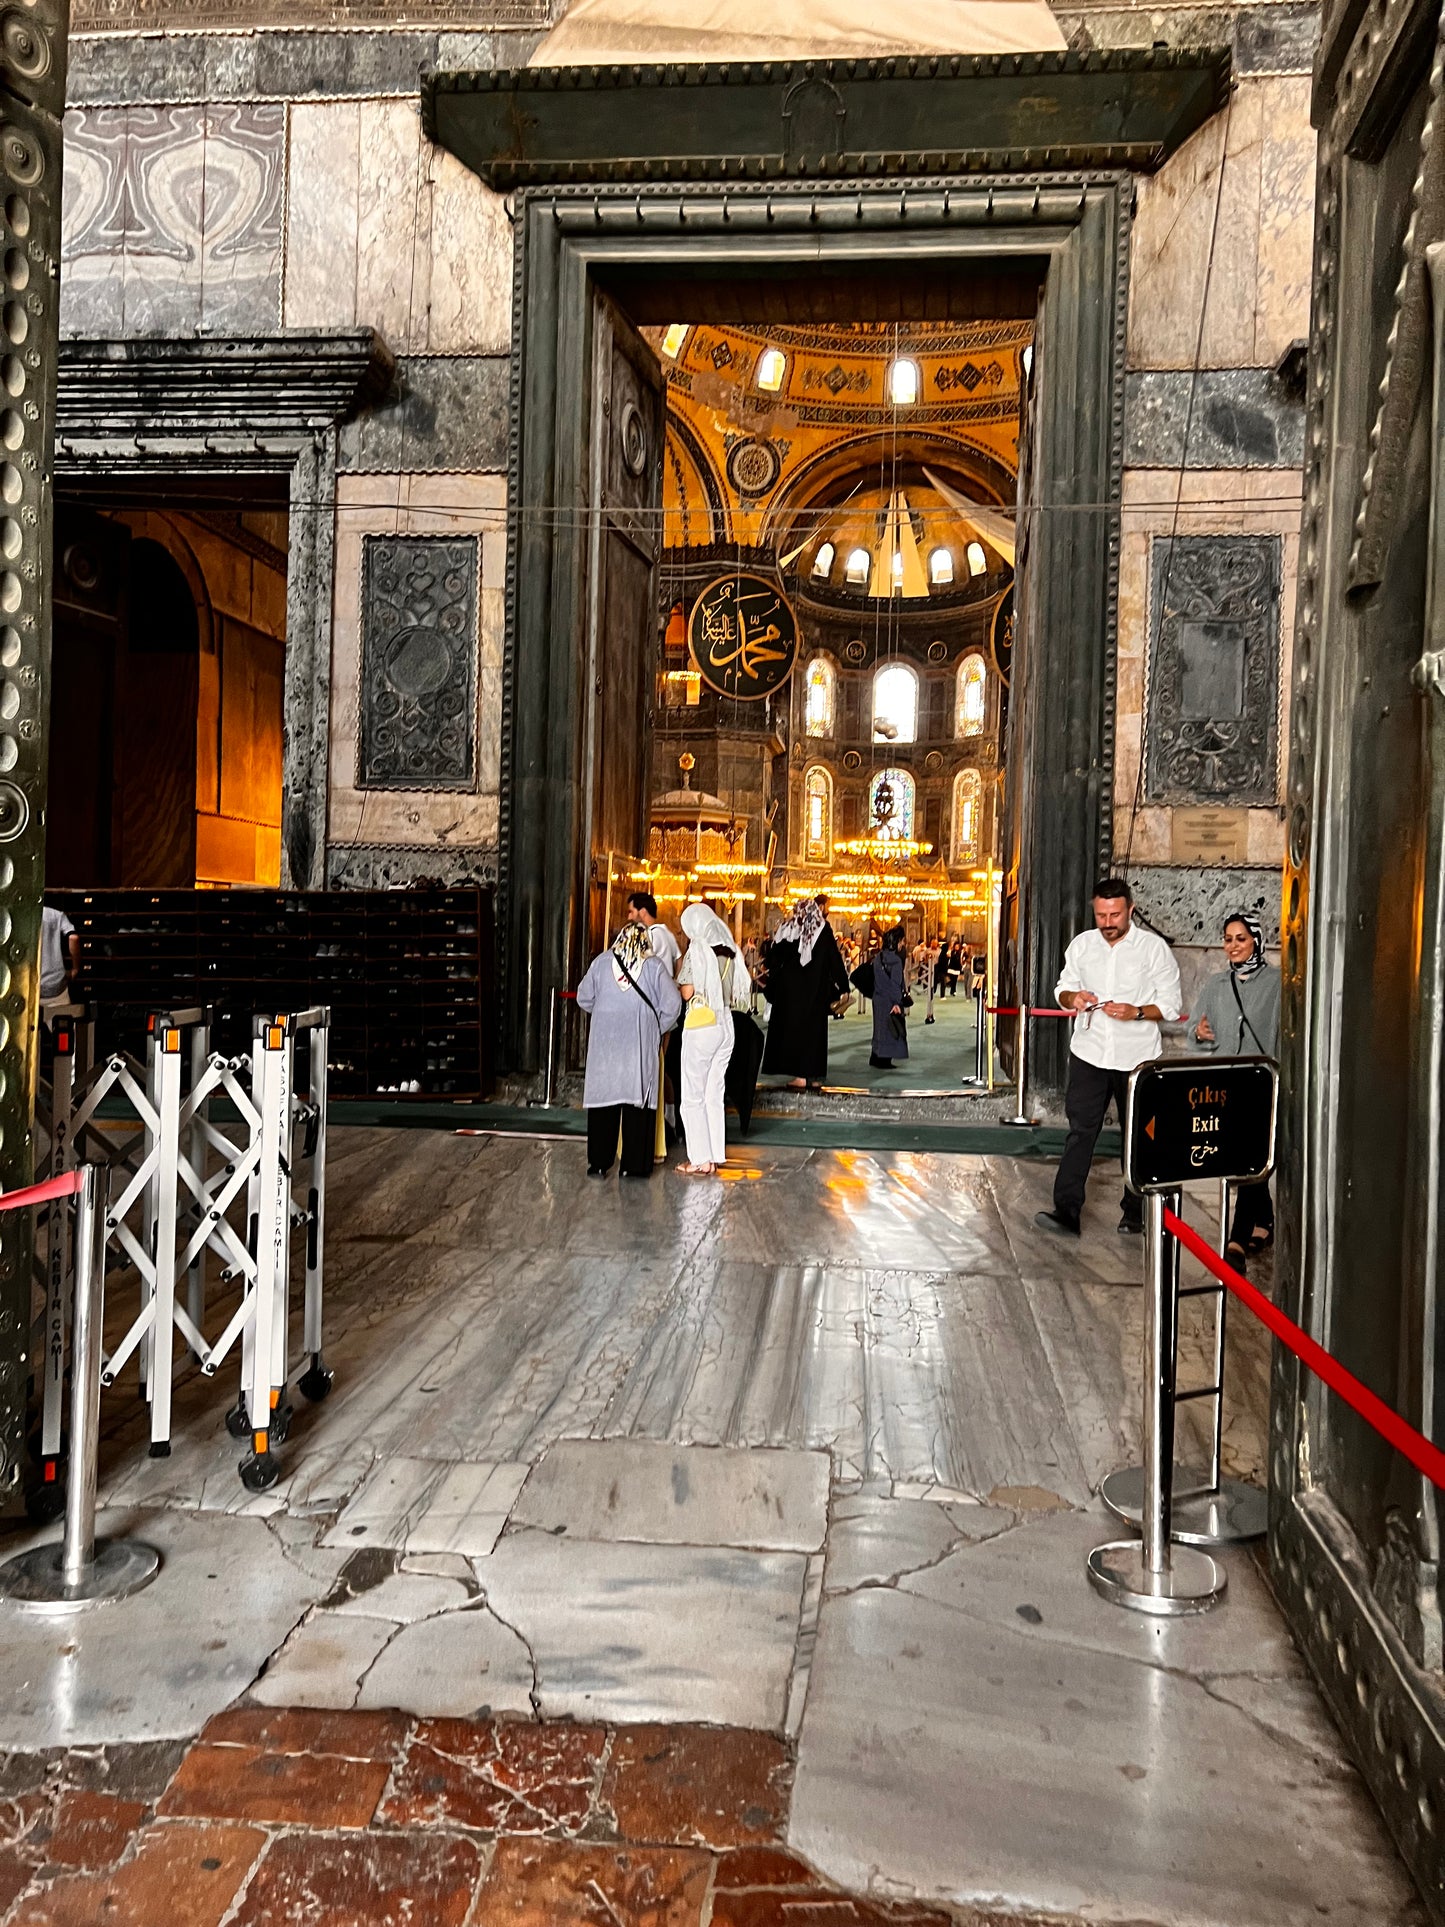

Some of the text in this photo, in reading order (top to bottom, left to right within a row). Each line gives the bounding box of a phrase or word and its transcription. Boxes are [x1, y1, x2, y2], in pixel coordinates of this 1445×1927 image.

[1188, 1086, 1227, 1110] Çıkış
[1192, 1115, 1220, 1133] Exit
[1190, 1140, 1219, 1167] مخرج
